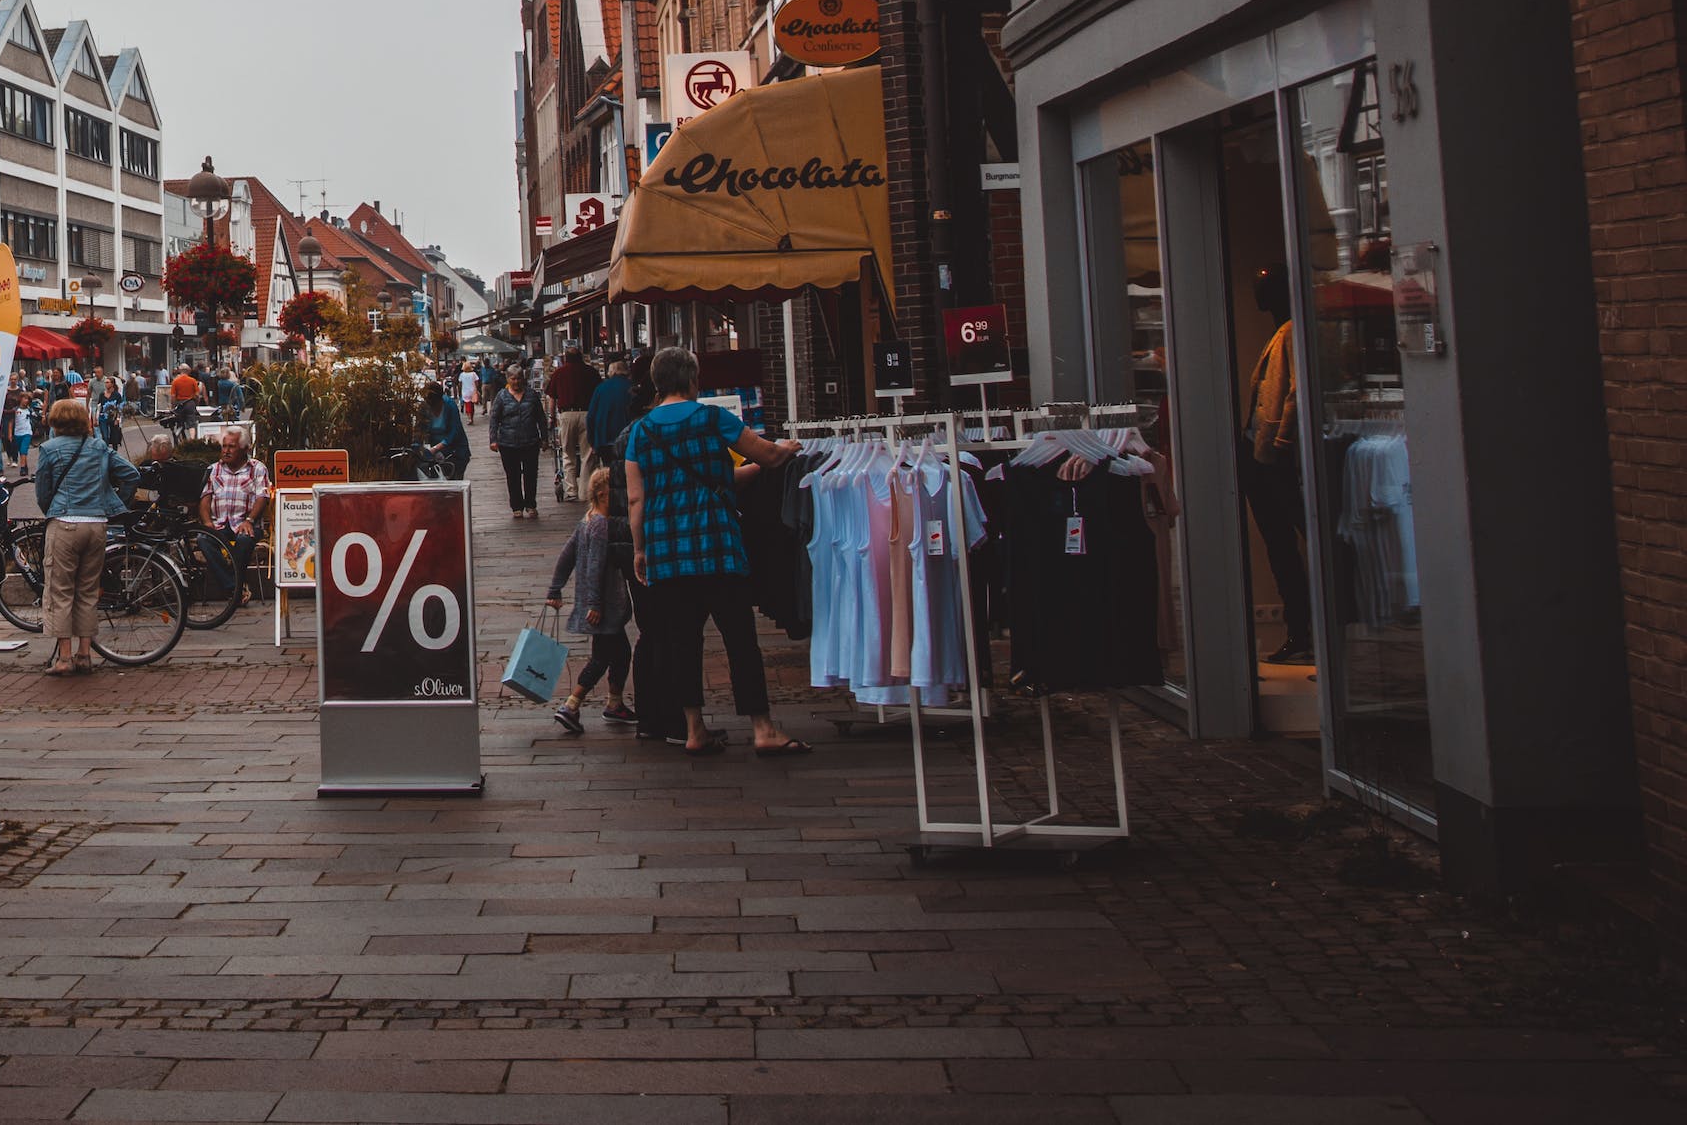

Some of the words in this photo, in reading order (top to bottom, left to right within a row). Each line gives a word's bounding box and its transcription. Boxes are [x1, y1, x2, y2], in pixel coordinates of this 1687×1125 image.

[663, 153, 886, 196] Chocolata
[279, 465, 344, 480] Chocolata
[283, 502, 314, 511] Kaubo
[330, 529, 461, 653] %
[414, 677, 464, 697] s.Oliver
